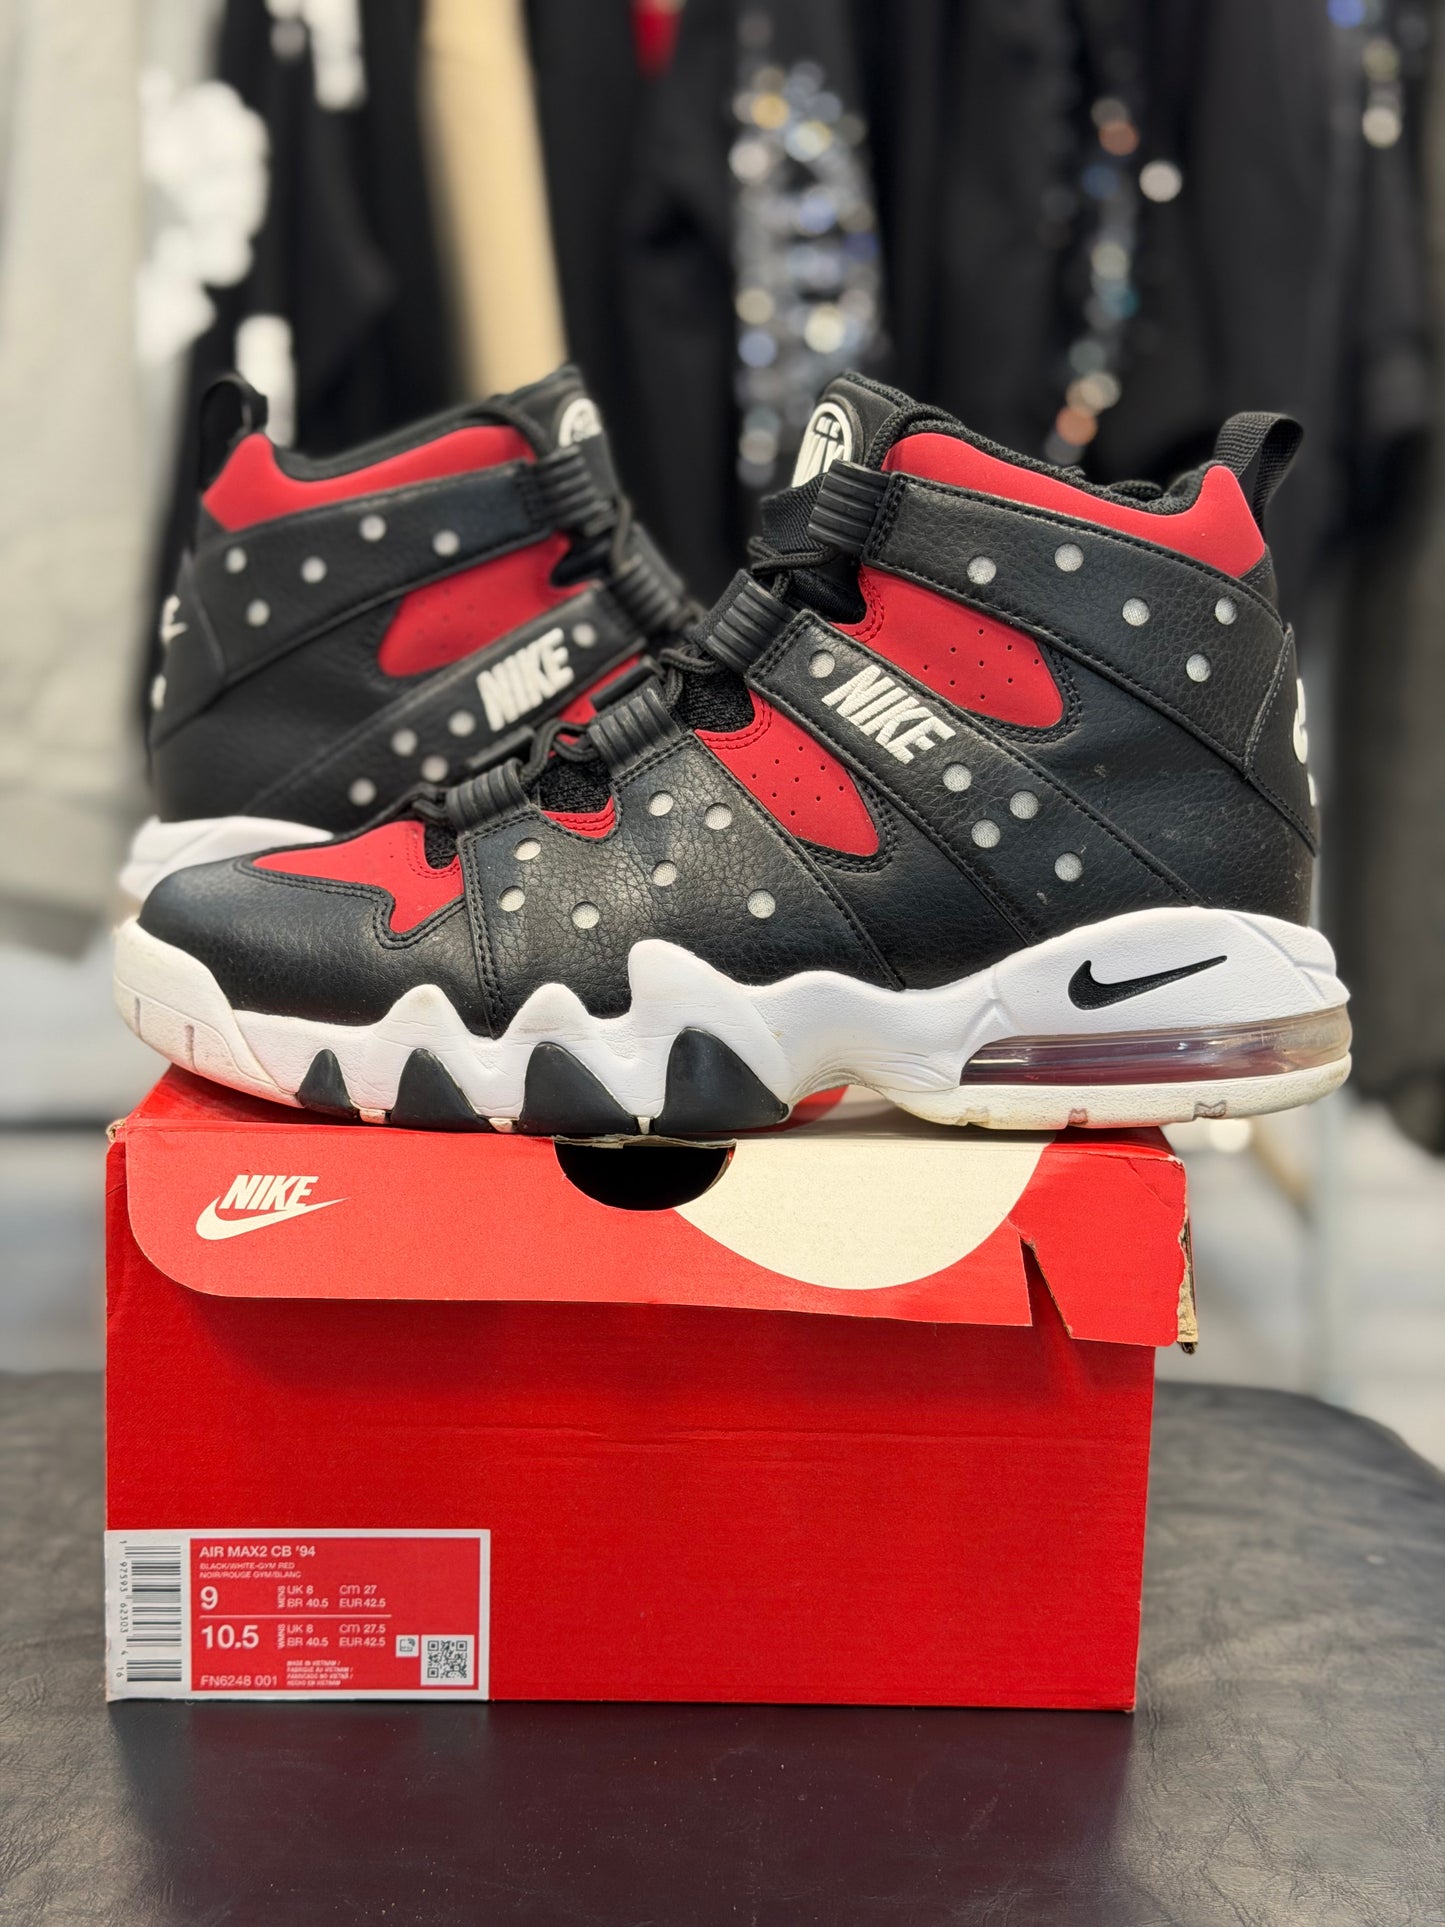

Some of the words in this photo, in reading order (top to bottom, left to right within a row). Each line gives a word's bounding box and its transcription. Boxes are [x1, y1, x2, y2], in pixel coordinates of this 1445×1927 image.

[476, 627, 574, 732] NIKE
[821, 664, 957, 765] NIKE
[218, 1174, 320, 1211] NIKE
[199, 1546, 224, 1557] AIR
[227, 1546, 268, 1557] MAX2
[270, 1545, 292, 1557] CB
[295, 1545, 316, 1557] '94
[199, 1562, 277, 1570] BLACK/WHITE-GYM
[278, 1562, 295, 1570] RED
[119, 1562, 128, 1593] 97593
[287, 1585, 303, 1594] UK
[306, 1585, 314, 1595] 8
[363, 1585, 377, 1594] 27
[200, 1586, 218, 1610] 9
[287, 1598, 303, 1608] BR
[306, 1598, 329, 1608] 40.5
[339, 1598, 362, 1608] EUR
[363, 1598, 386, 1608] 42.5
[120, 1603, 129, 1634] 62303
[287, 1624, 303, 1634] UK
[306, 1624, 314, 1634] 8
[363, 1624, 386, 1634] 27.5
[201, 1624, 259, 1649] 10.5
[287, 1637, 303, 1647] BR
[306, 1637, 329, 1647] 40.5
[339, 1637, 362, 1647] EUR
[363, 1637, 386, 1647] 42.5
[116, 1667, 124, 1678] 16
[200, 1675, 252, 1686] FN6248
[255, 1675, 278, 1686] 001
